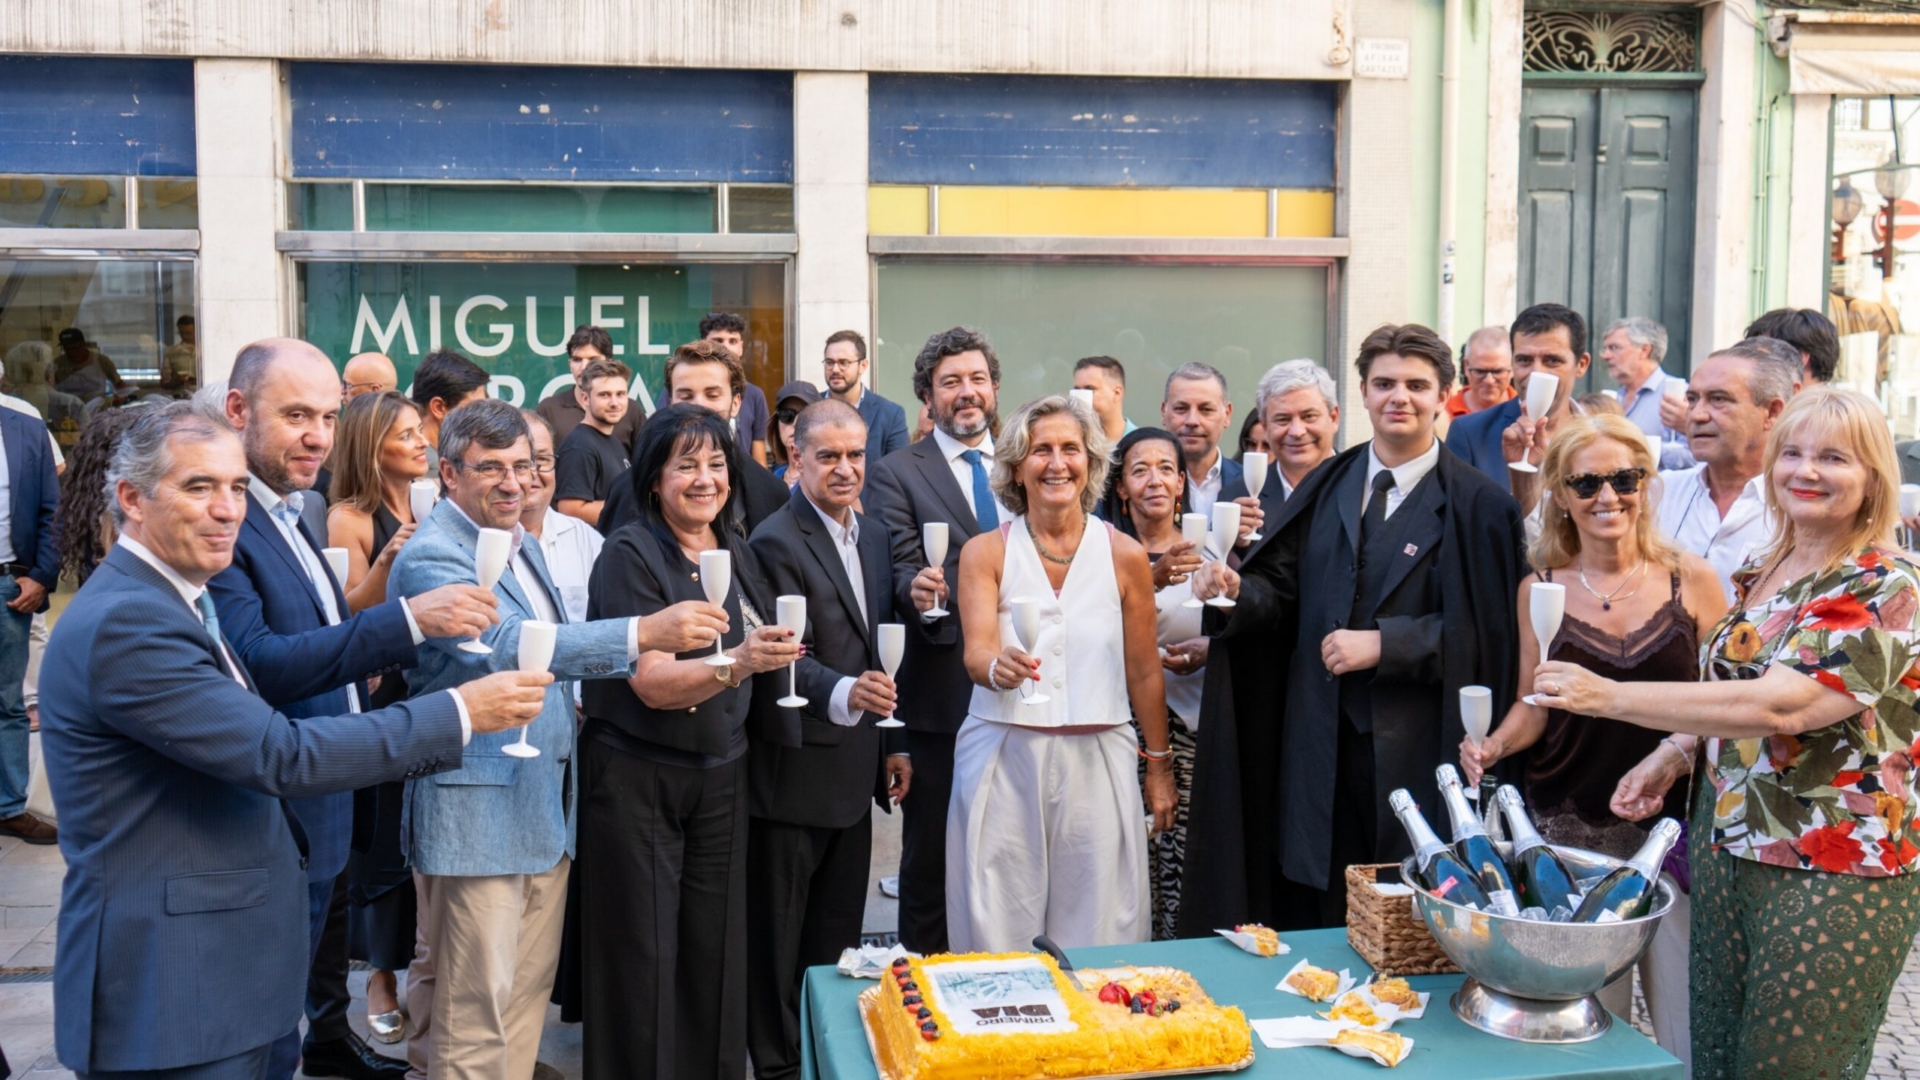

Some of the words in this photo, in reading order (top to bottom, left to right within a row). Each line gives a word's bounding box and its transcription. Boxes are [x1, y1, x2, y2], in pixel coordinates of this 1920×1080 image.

[350, 293, 670, 357] MIGUEL
[971, 1004, 1052, 1019] DIA
[976, 1016, 1055, 1026] PRIMEIRO
